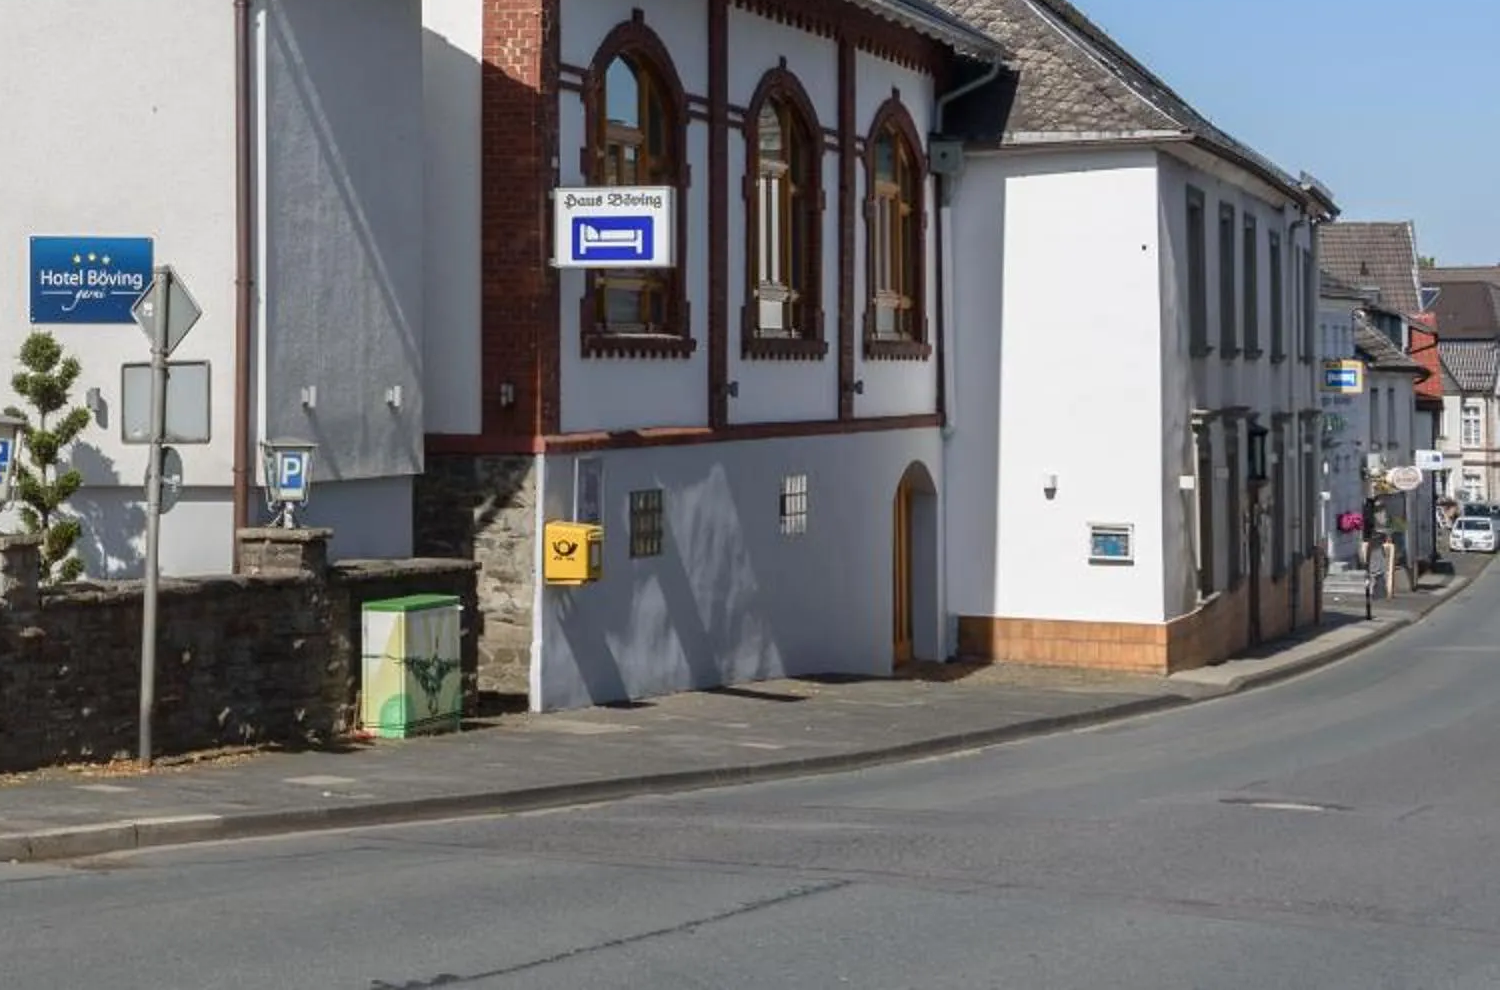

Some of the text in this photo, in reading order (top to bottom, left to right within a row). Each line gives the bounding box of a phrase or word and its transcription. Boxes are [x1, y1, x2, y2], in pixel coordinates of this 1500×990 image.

[564, 194, 602, 209] Haus
[41, 269, 143, 290] Hotel Böving
[282, 457, 301, 485] P
